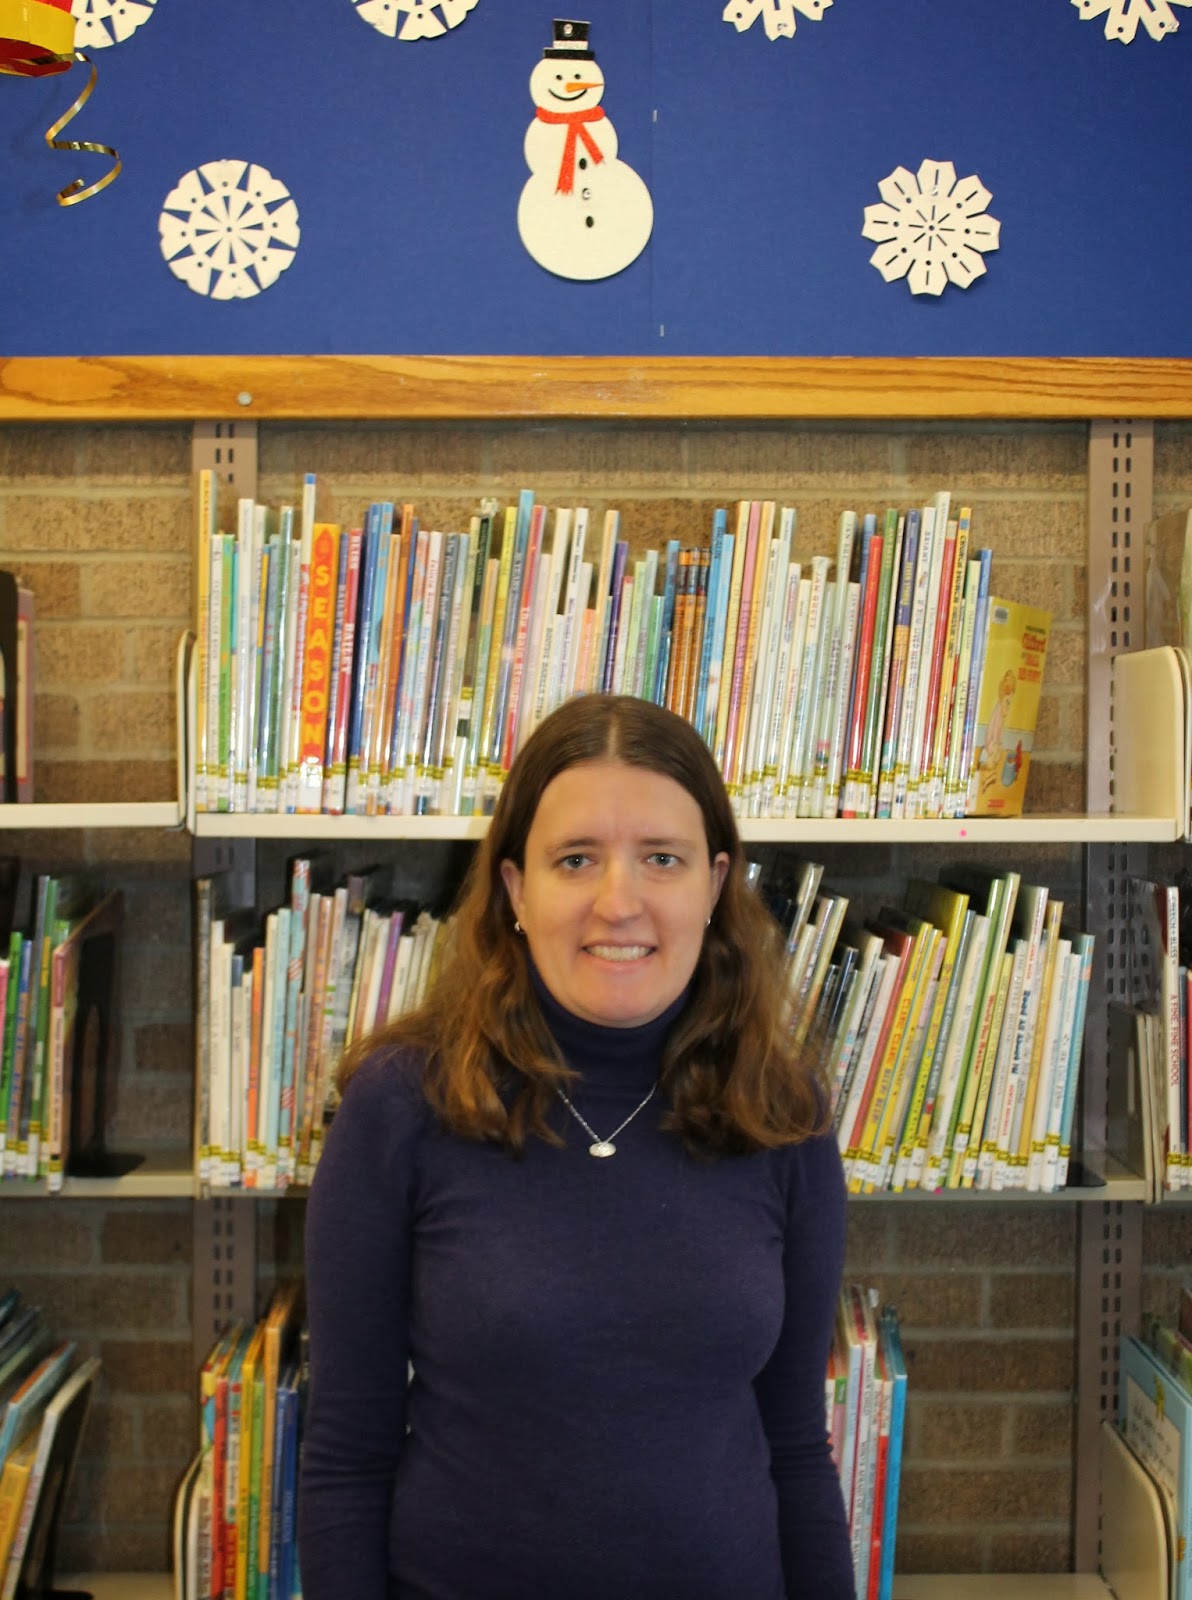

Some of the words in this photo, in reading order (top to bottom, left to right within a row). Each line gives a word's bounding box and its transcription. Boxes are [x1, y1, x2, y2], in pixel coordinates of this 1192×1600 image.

[713, 526, 724, 559] BRAUN
[843, 522, 852, 540] JAN
[348, 535, 361, 569] BLISS
[841, 543, 851, 571] BRETT
[921, 530, 931, 564] BRIANT
[956, 534, 968, 568] CRUNCH
[813, 570, 822, 591] JAN
[334, 584, 346, 624] BAILEY
[809, 595, 819, 630] BRETT
[333, 628, 344, 642] AT
[738, 609, 750, 638] LOVE
[340, 623, 355, 674] BAILEY
[515, 632, 527, 658] Rain
[1168, 937, 1178, 958] BLISS
[1020, 990, 1032, 1015] Read
[1168, 993, 1178, 1001] A
[1017, 1018, 1028, 1031] All
[1168, 1027, 1179, 1046] FINE
[1013, 1033, 1026, 1061] About
[1169, 1048, 1179, 1087] SCHOOL
